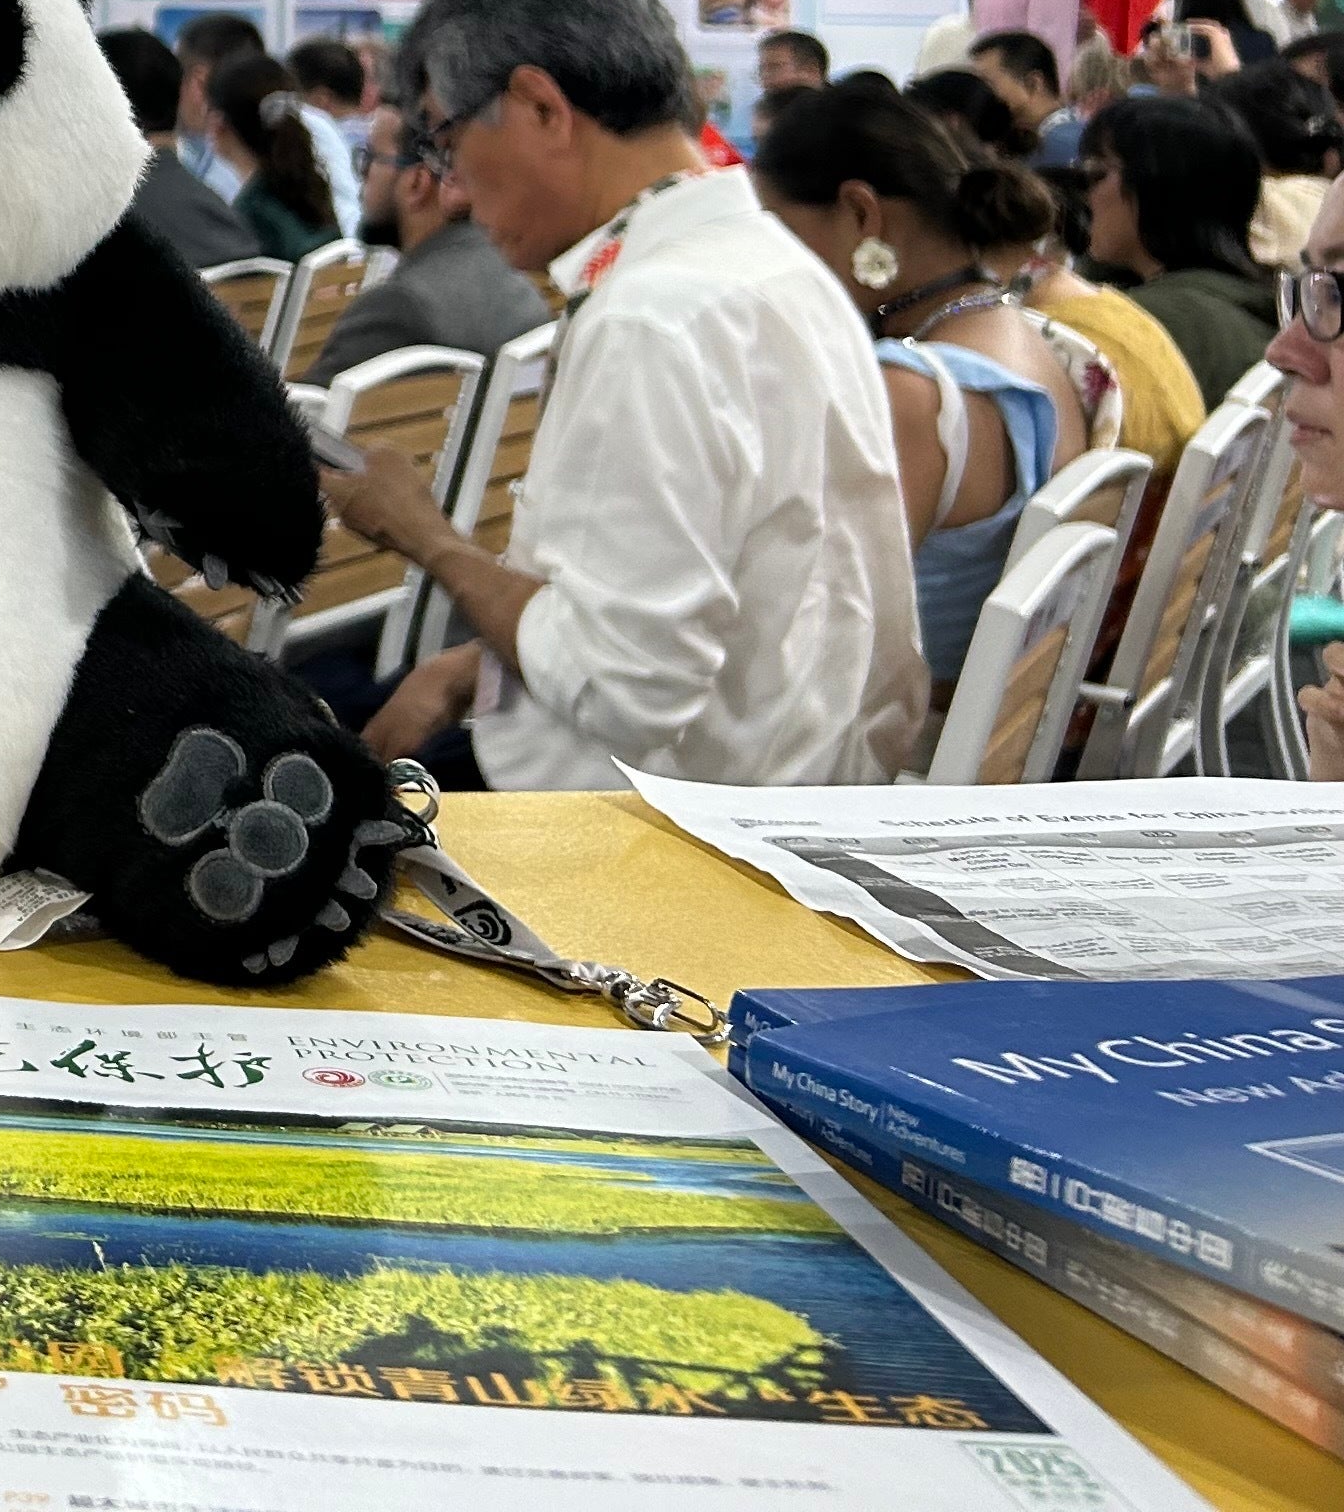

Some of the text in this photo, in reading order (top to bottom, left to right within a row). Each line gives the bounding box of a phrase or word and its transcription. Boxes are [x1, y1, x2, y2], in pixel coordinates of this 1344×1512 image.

[878, 815, 999, 828] Schedule
[1006, 814, 1033, 823] of
[1035, 813, 1127, 823] Events
[1128, 811, 1168, 819] for
[1173, 810, 1249, 820] China
[287, 1035, 656, 1068] ENVIRONMENTAL
[293, 1048, 568, 1073] PROTECTION
[952, 1032, 1342, 1084] My China
[772, 1061, 795, 1089] My
[796, 1071, 838, 1103] China
[838, 1088, 879, 1124] Story
[1155, 1082, 1286, 1107] New
[886, 1120, 967, 1165] Adventures
